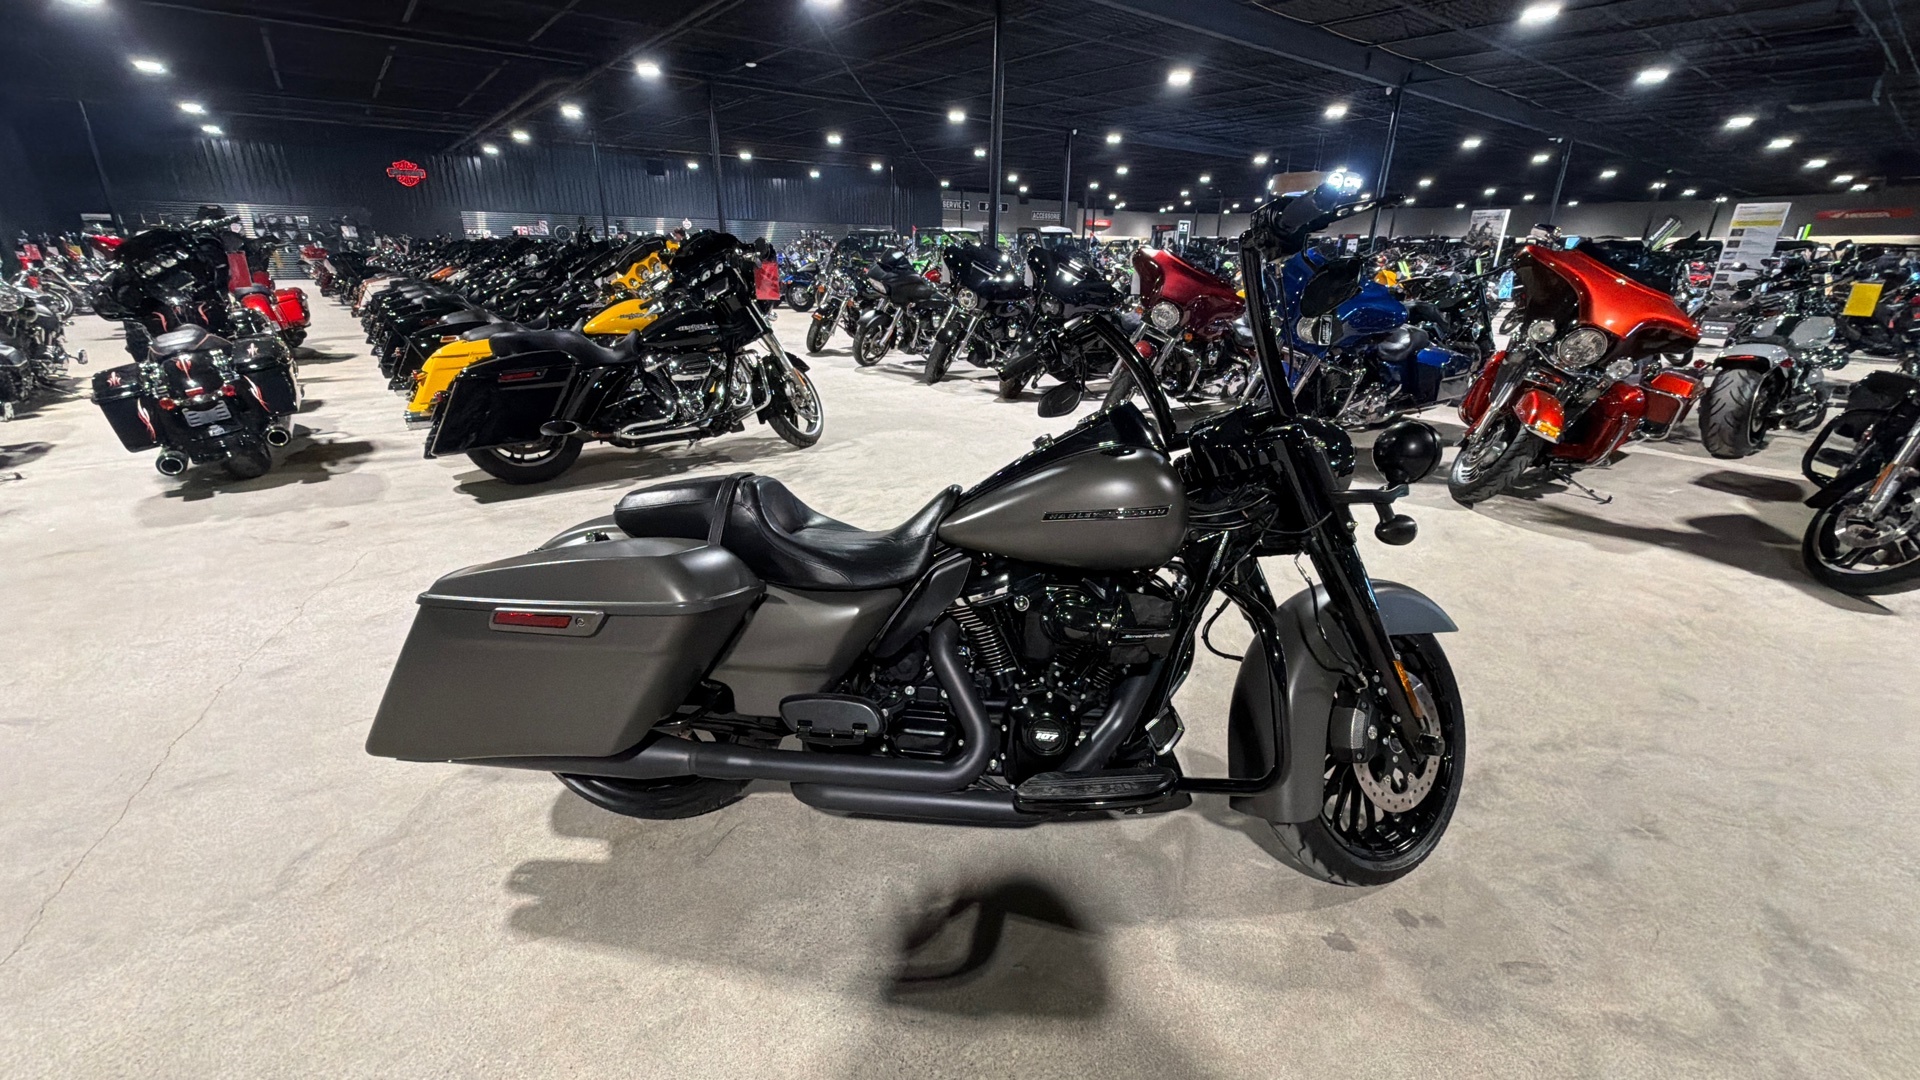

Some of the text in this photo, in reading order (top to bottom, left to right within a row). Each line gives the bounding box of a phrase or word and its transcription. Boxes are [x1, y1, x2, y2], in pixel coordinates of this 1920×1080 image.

[942, 200, 966, 209] SERVICE
[1032, 212, 1061, 220] ACCESSORIE
[1035, 732, 1059, 740] 107
